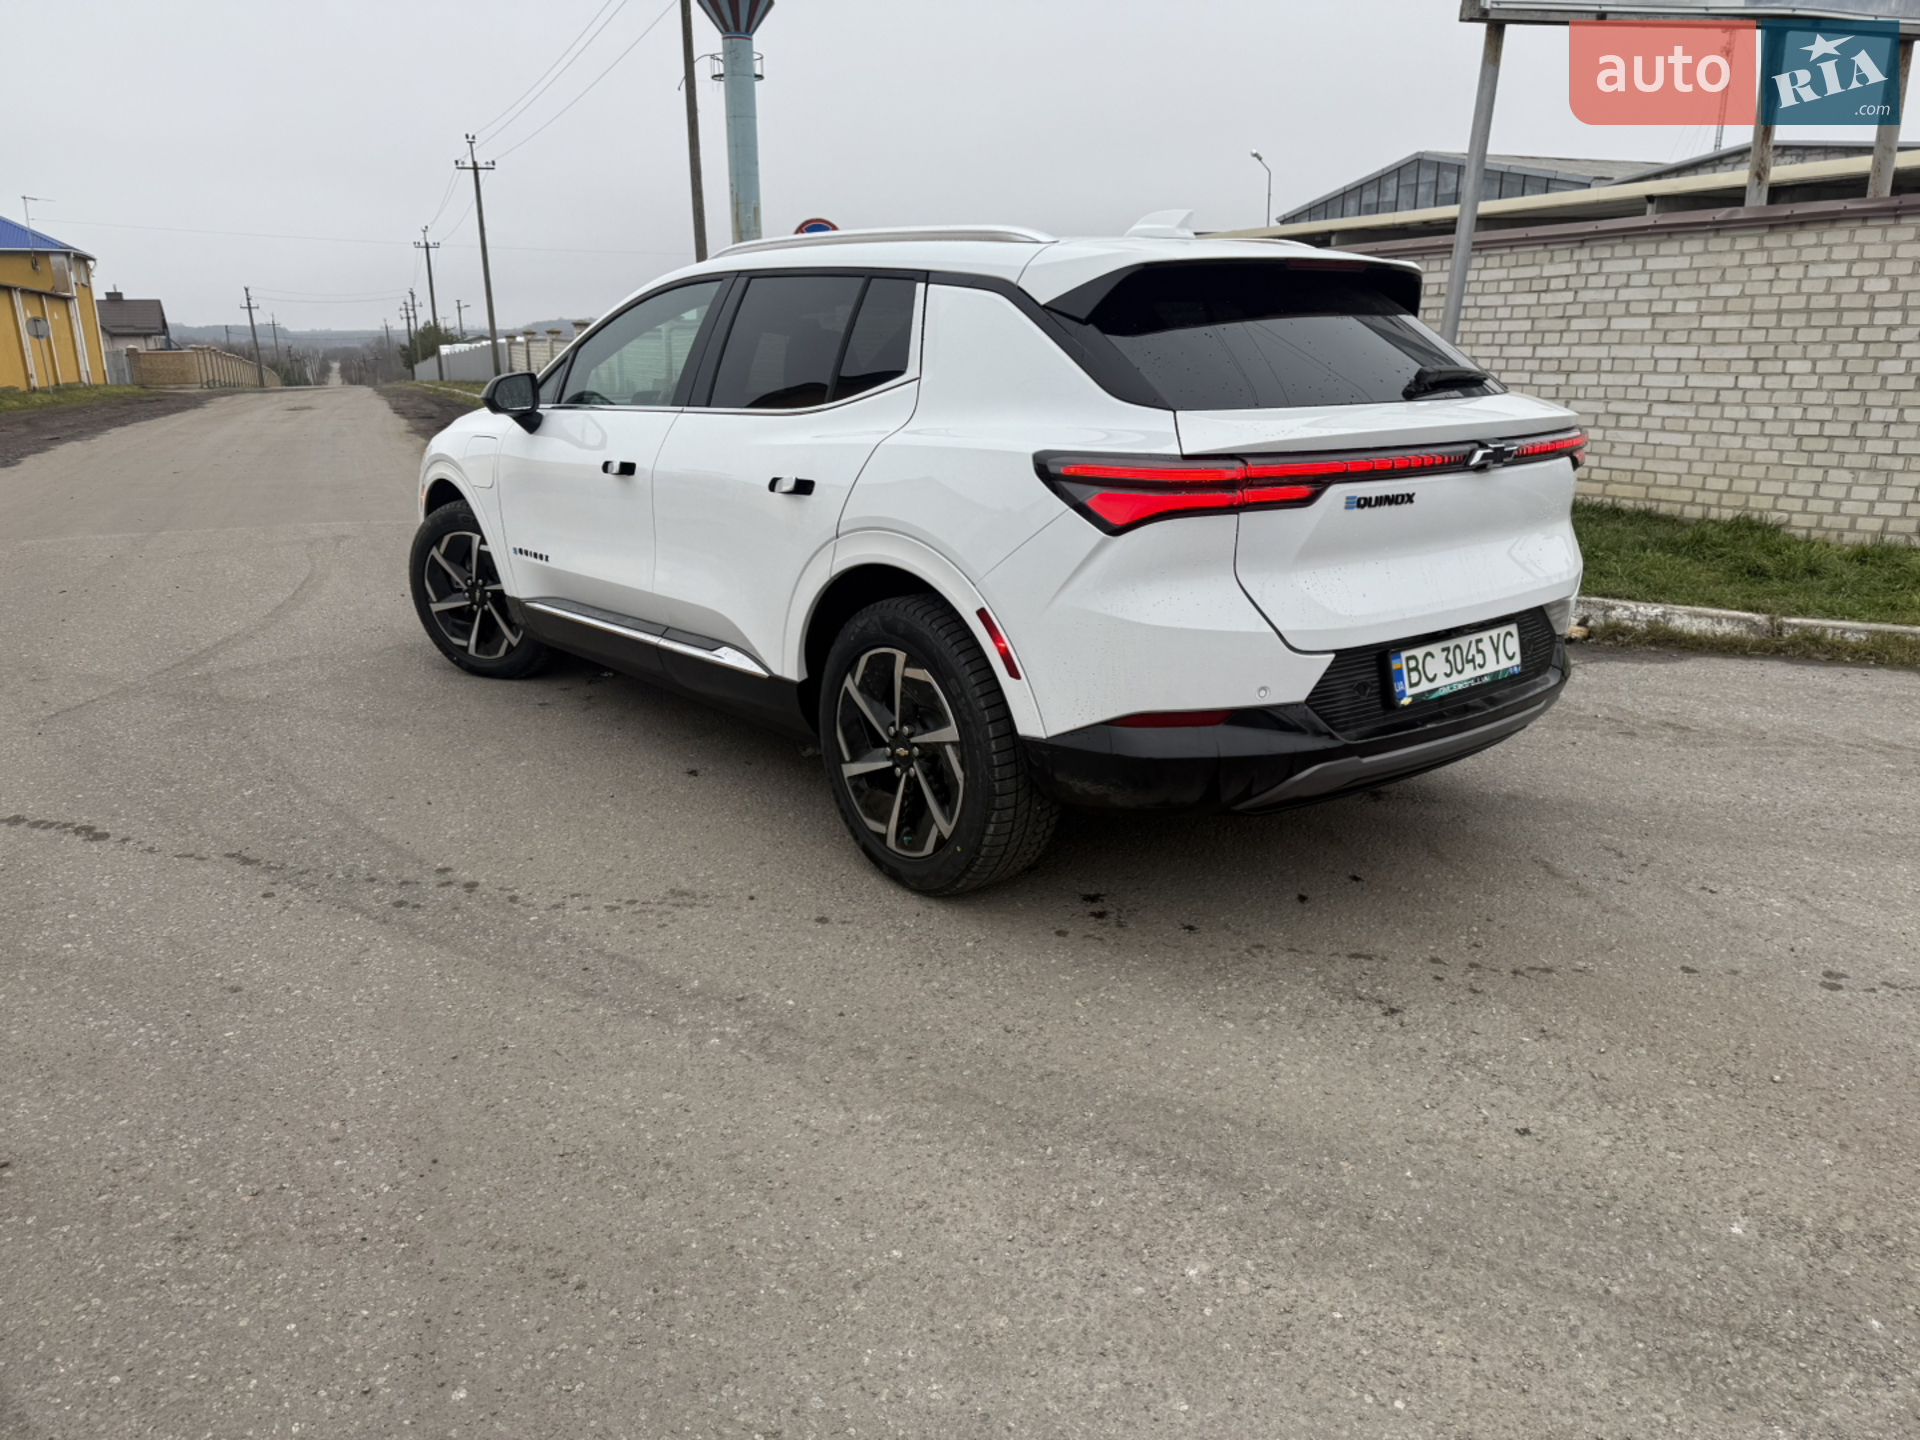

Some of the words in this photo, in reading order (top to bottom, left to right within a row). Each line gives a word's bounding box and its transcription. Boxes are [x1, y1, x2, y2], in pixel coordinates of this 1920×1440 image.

[1344, 492, 1416, 510] EQUINOX
[1404, 651, 1438, 689] BC
[1441, 637, 1487, 678] 3045
[1489, 630, 1517, 665] YC
[1394, 681, 1406, 692] UA
